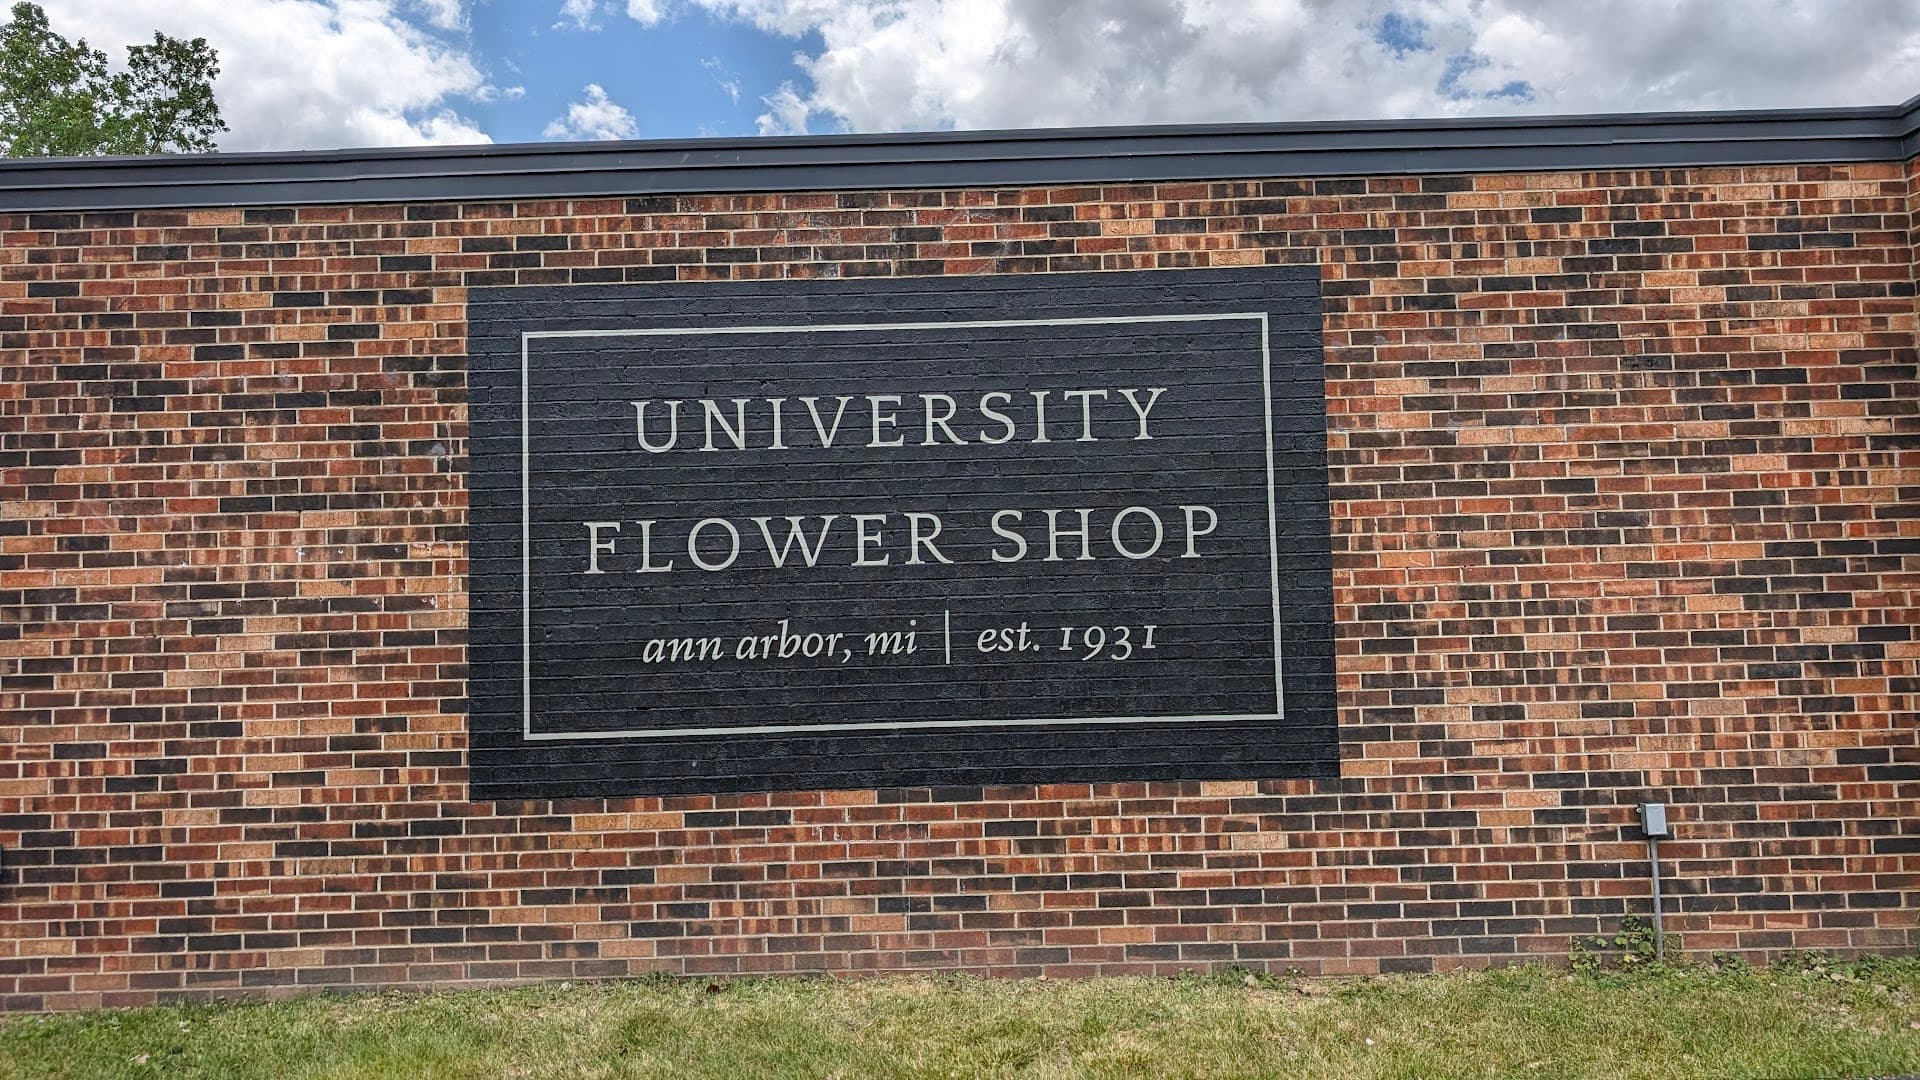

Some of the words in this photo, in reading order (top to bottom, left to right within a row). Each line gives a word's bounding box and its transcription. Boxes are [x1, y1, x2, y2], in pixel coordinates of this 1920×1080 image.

[630, 387, 1168, 454] UNIVERSITY
[582, 512, 953, 575] FLOWER
[990, 505, 1218, 564] SHOP
[642, 637, 725, 665] ann
[734, 618, 852, 664] arbor,
[863, 620, 918, 655] mi
[977, 622, 1041, 654] est.
[1059, 625, 1158, 661] 1931
